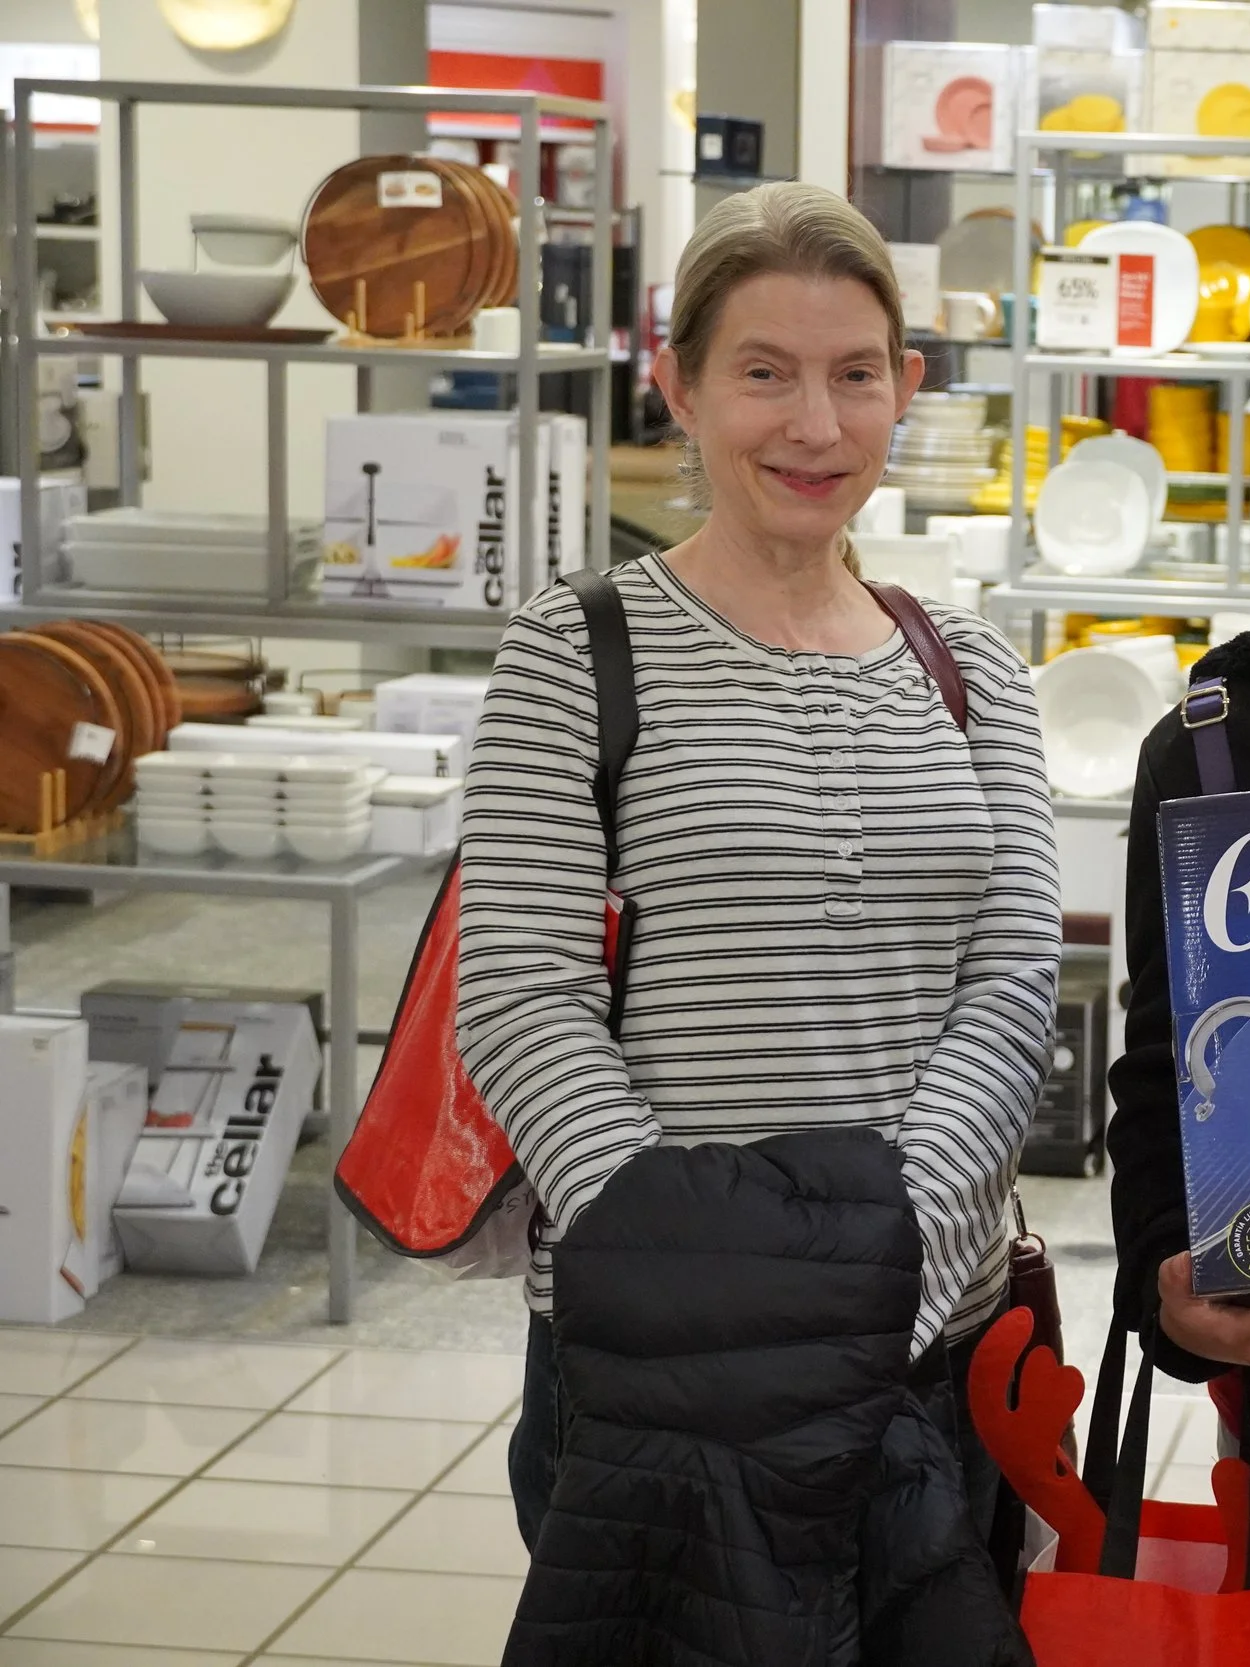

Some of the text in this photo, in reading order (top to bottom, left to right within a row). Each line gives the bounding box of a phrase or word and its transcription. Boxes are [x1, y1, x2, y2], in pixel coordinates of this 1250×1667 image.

[479, 465, 506, 607] cellar
[205, 1053, 285, 1217] the cellar
